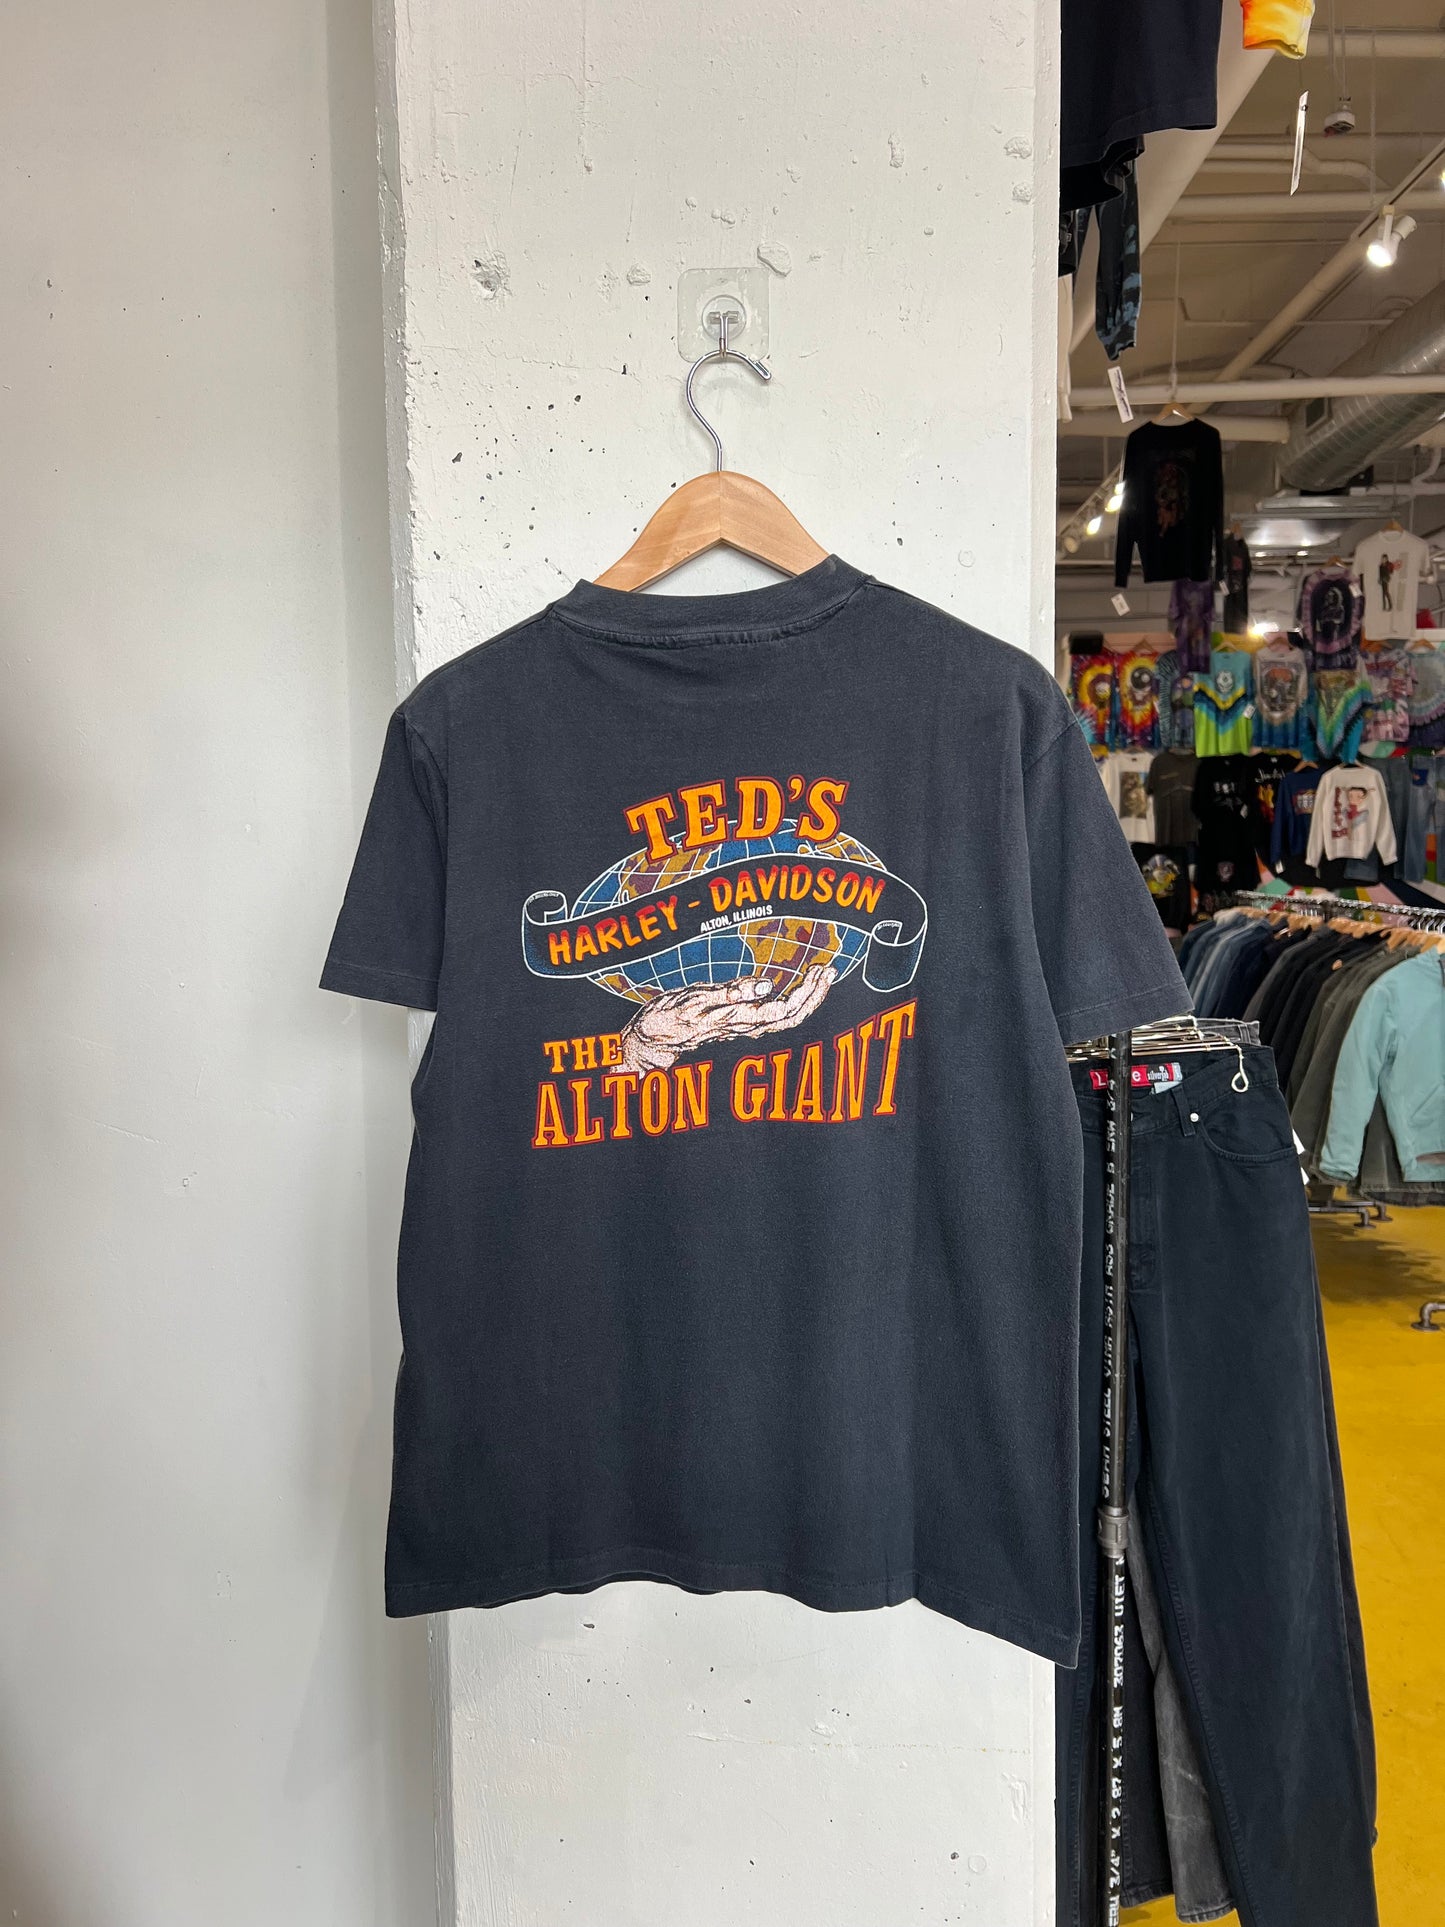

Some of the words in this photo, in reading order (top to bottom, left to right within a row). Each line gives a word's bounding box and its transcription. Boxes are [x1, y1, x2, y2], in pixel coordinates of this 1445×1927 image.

[624, 775, 849, 863] TED'S
[548, 895, 679, 967] HARLEY
[708, 864, 886, 914] DAVIDSON
[700, 916, 732, 933] ALTON,
[733, 905, 773, 925] ILLINOIS
[531, 1061, 713, 1149] ALTON
[730, 997, 919, 1125] GIANT
[542, 1033, 623, 1074] THE
